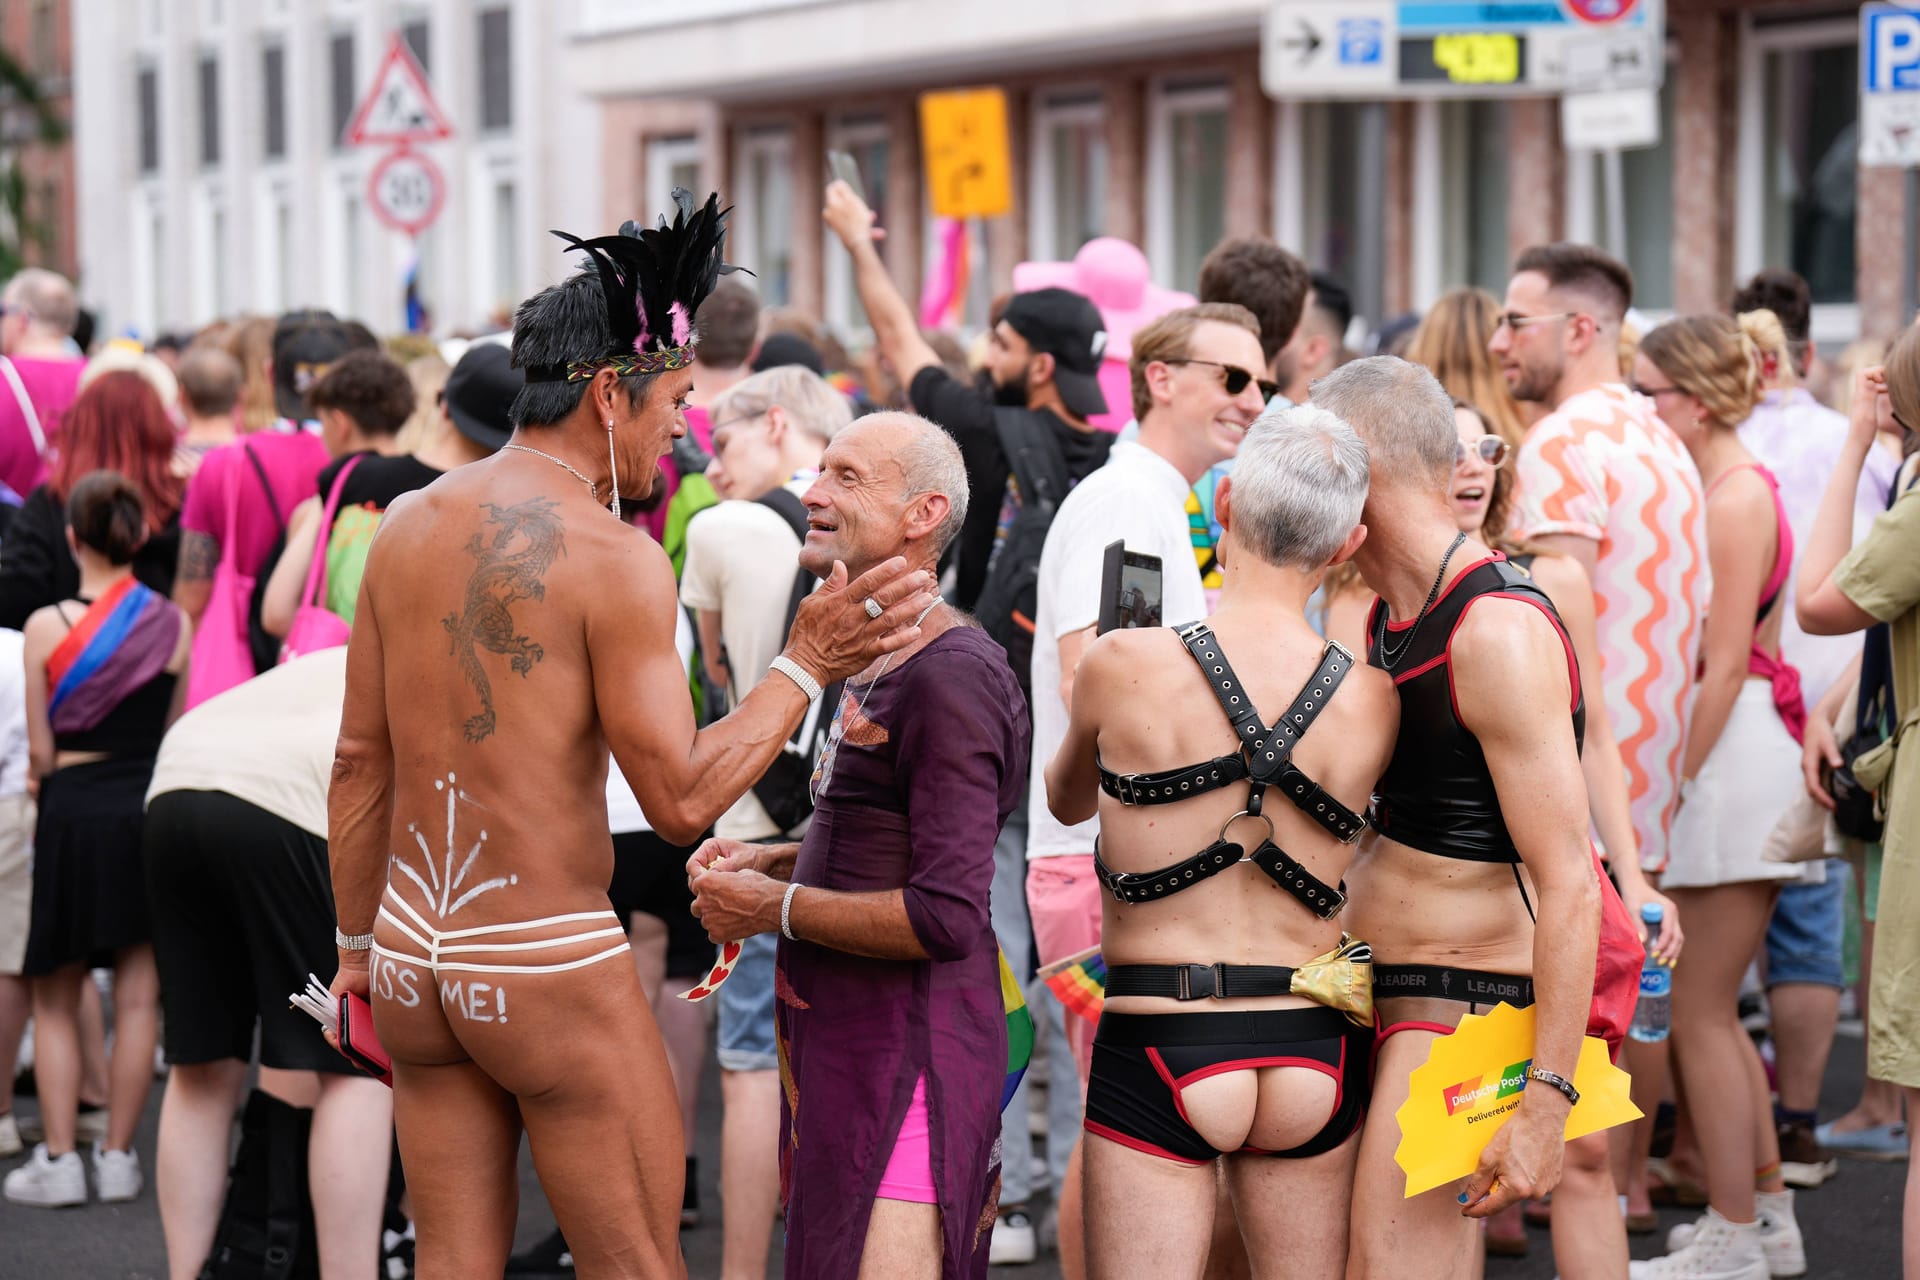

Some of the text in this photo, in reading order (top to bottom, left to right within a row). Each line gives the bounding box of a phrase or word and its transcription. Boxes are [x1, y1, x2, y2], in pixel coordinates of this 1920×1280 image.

[1380, 974, 1520, 998] LEADER LEADER
[441, 979, 508, 1024] ME!
[1452, 1073, 1525, 1107] Deutsche Post
[1467, 1105, 1506, 1125] Delivered
